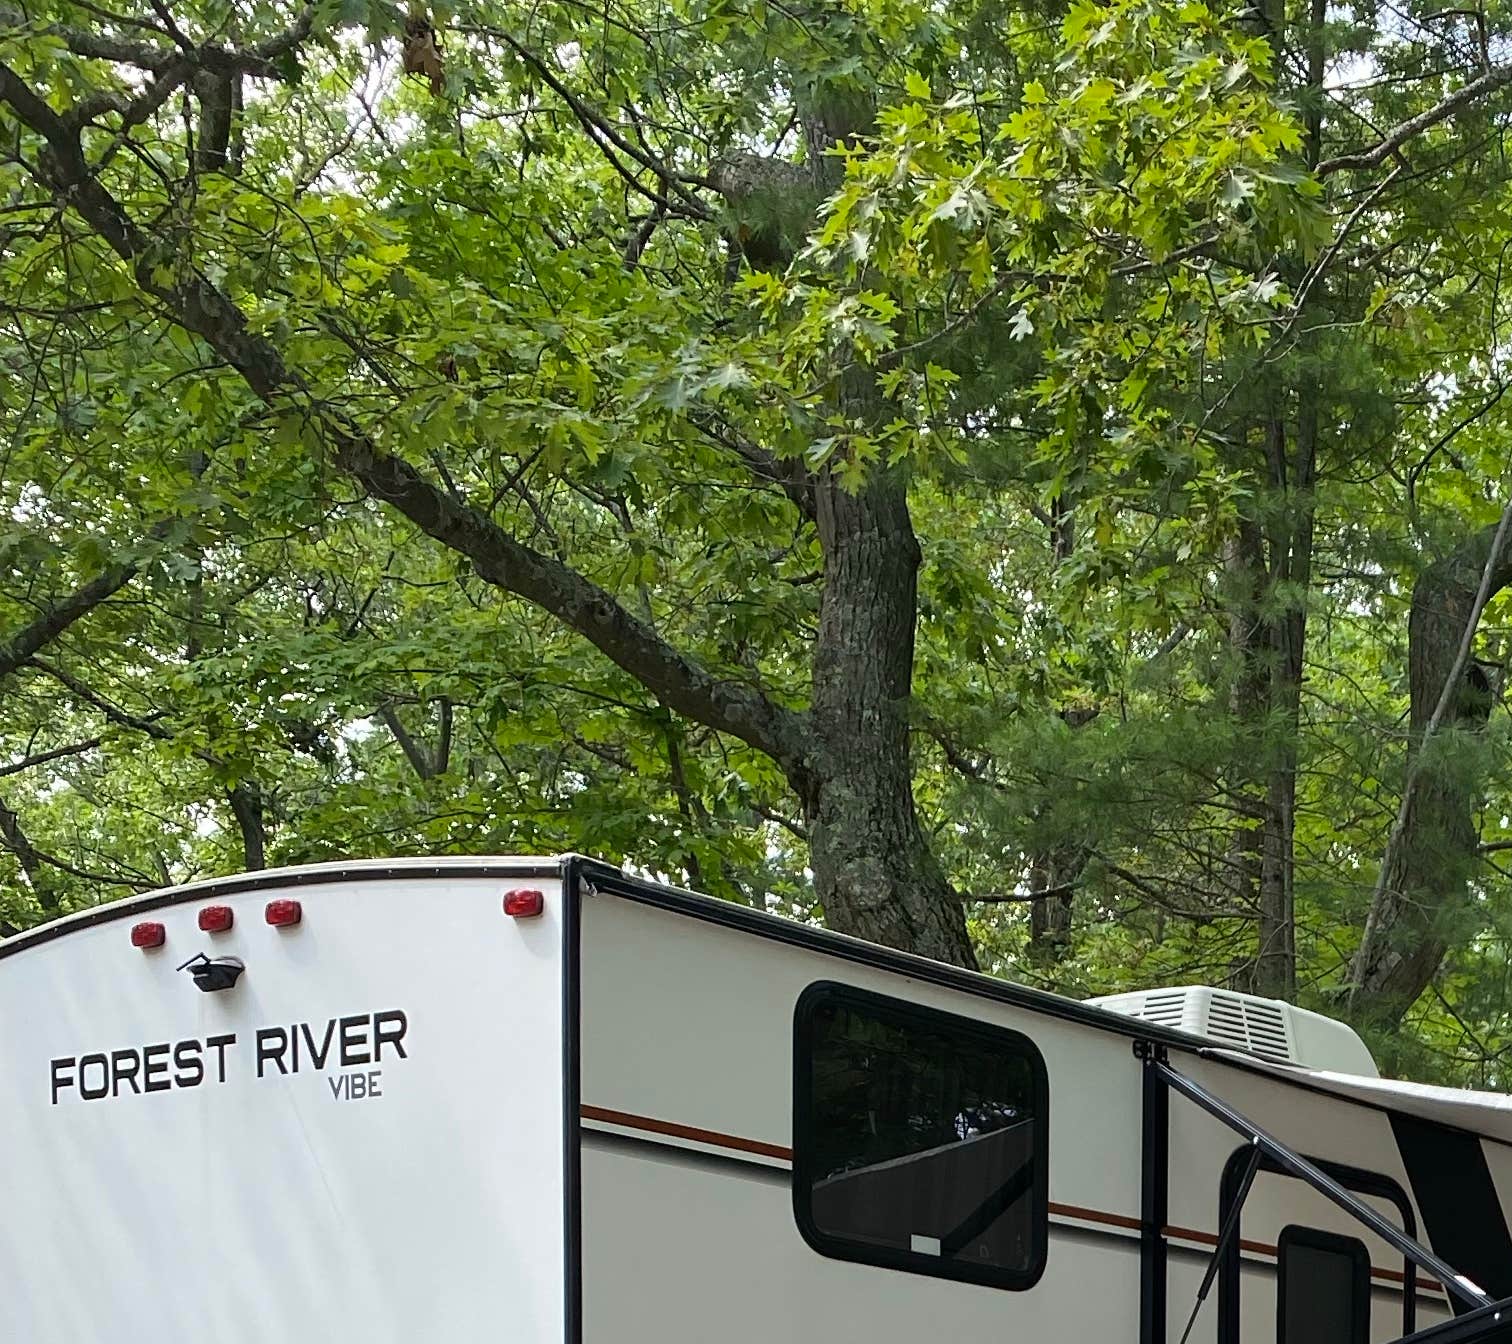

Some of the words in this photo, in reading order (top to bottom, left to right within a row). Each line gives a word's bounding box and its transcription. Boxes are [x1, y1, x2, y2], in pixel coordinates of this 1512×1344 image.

[49, 1033, 237, 1106] FOREST
[255, 1008, 409, 1079] RIVER
[327, 1070, 383, 1101] VIBE
